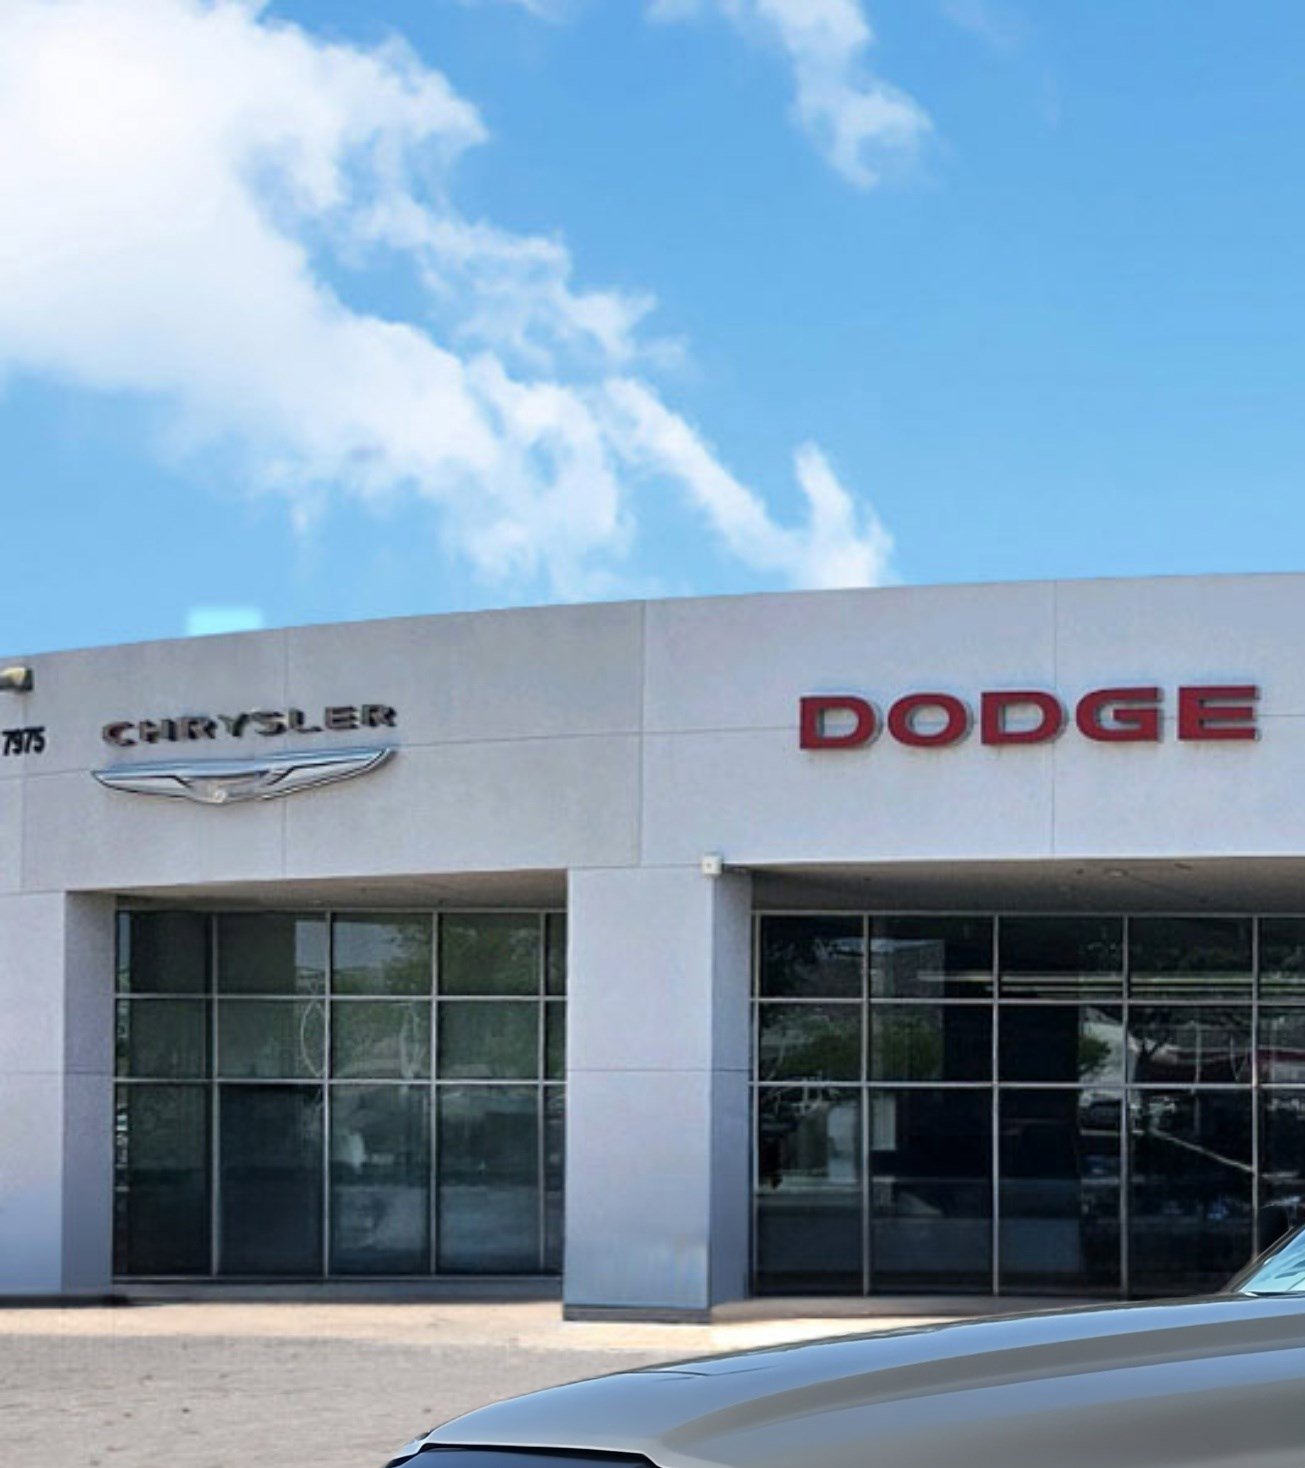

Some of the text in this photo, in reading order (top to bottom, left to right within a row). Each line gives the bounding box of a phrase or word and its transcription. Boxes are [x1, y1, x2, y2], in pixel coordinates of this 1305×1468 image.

[102, 703, 398, 747] CHRYSLER
[799, 684, 1261, 750] DODGE
[1, 726, 46, 757] 7975
